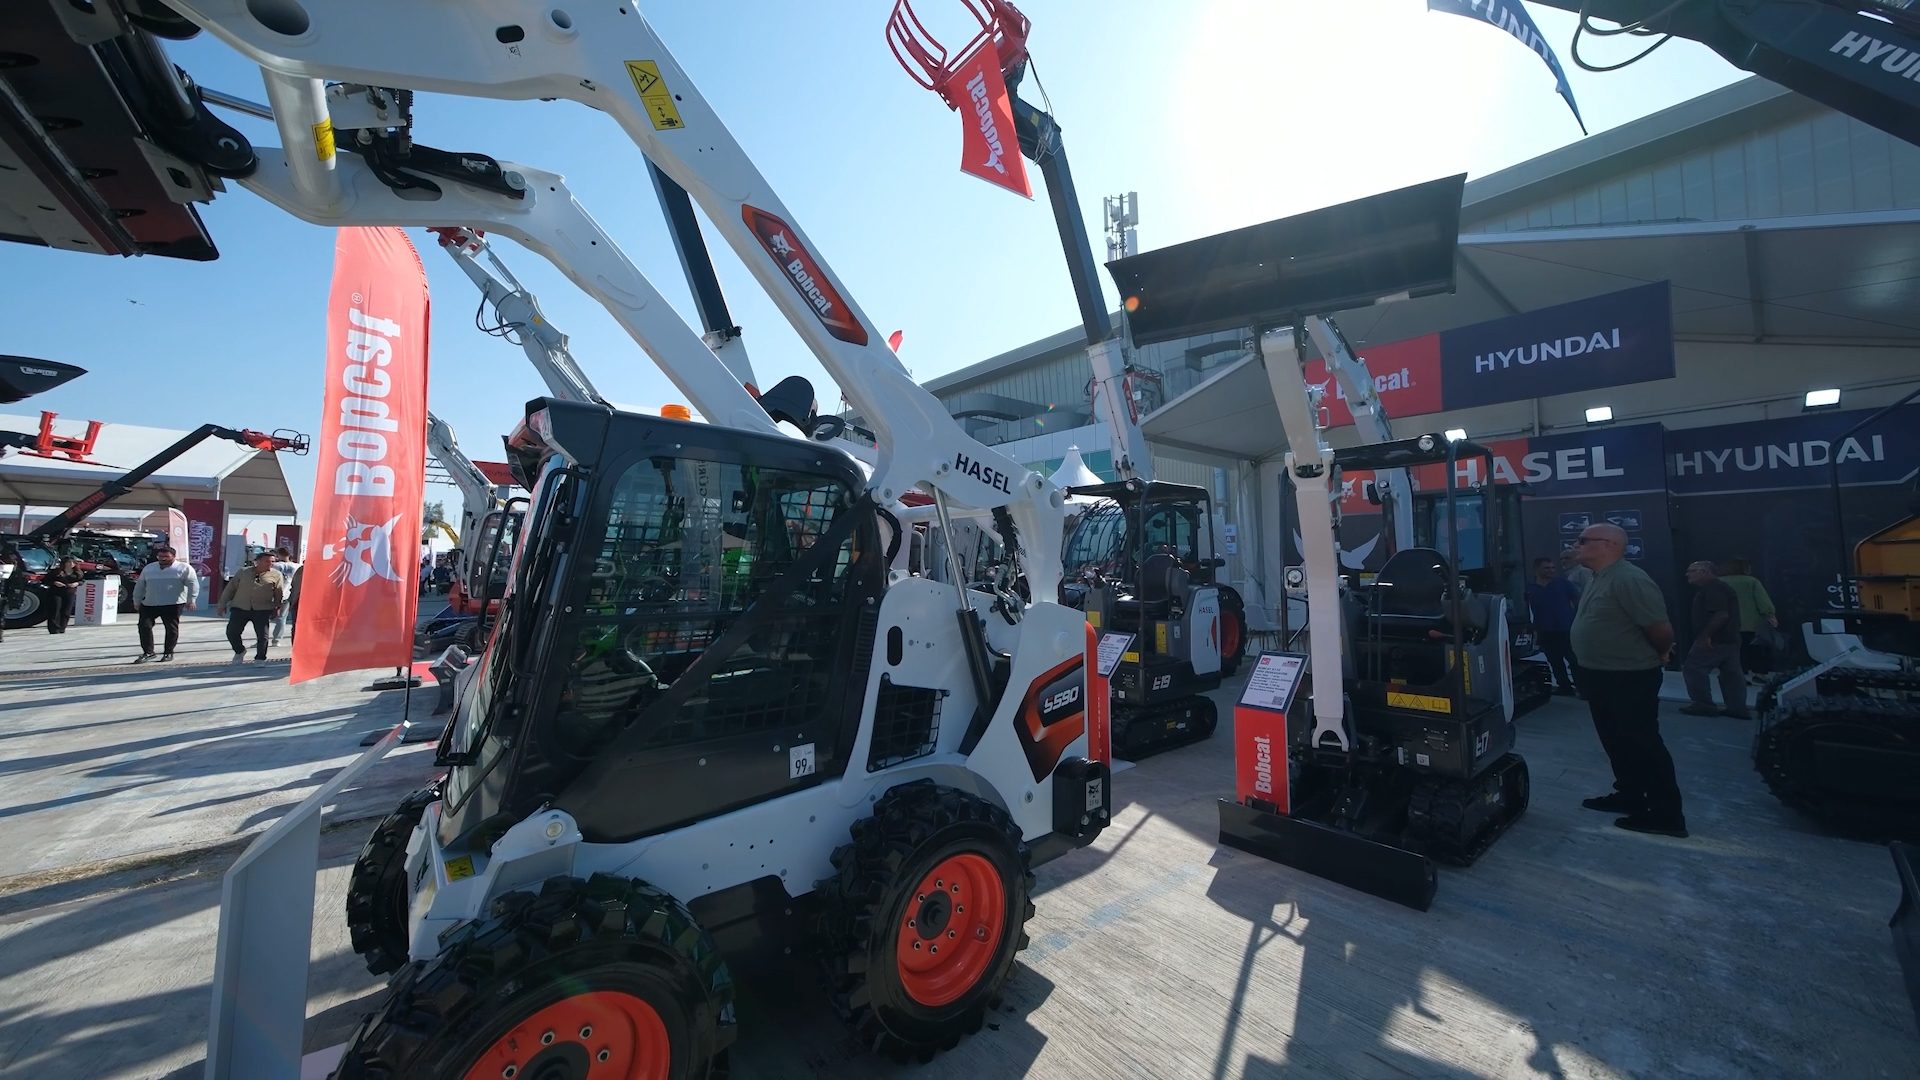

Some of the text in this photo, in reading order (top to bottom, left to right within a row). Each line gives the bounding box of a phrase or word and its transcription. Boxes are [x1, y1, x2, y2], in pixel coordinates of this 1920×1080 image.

[787, 258, 833, 314] Bobcat
[1475, 327, 1621, 374] HYUNDAI
[955, 452, 1011, 495] HASEL
[1454, 445, 1625, 489] HASEL
[1675, 434, 1885, 476] HYUNDAI
[84, 583, 96, 615] MANITOU
[1043, 686, 1079, 714] S590
[1152, 674, 1171, 691] E19
[795, 758, 807, 775] 99
[1254, 736, 1272, 794] Bobcat
